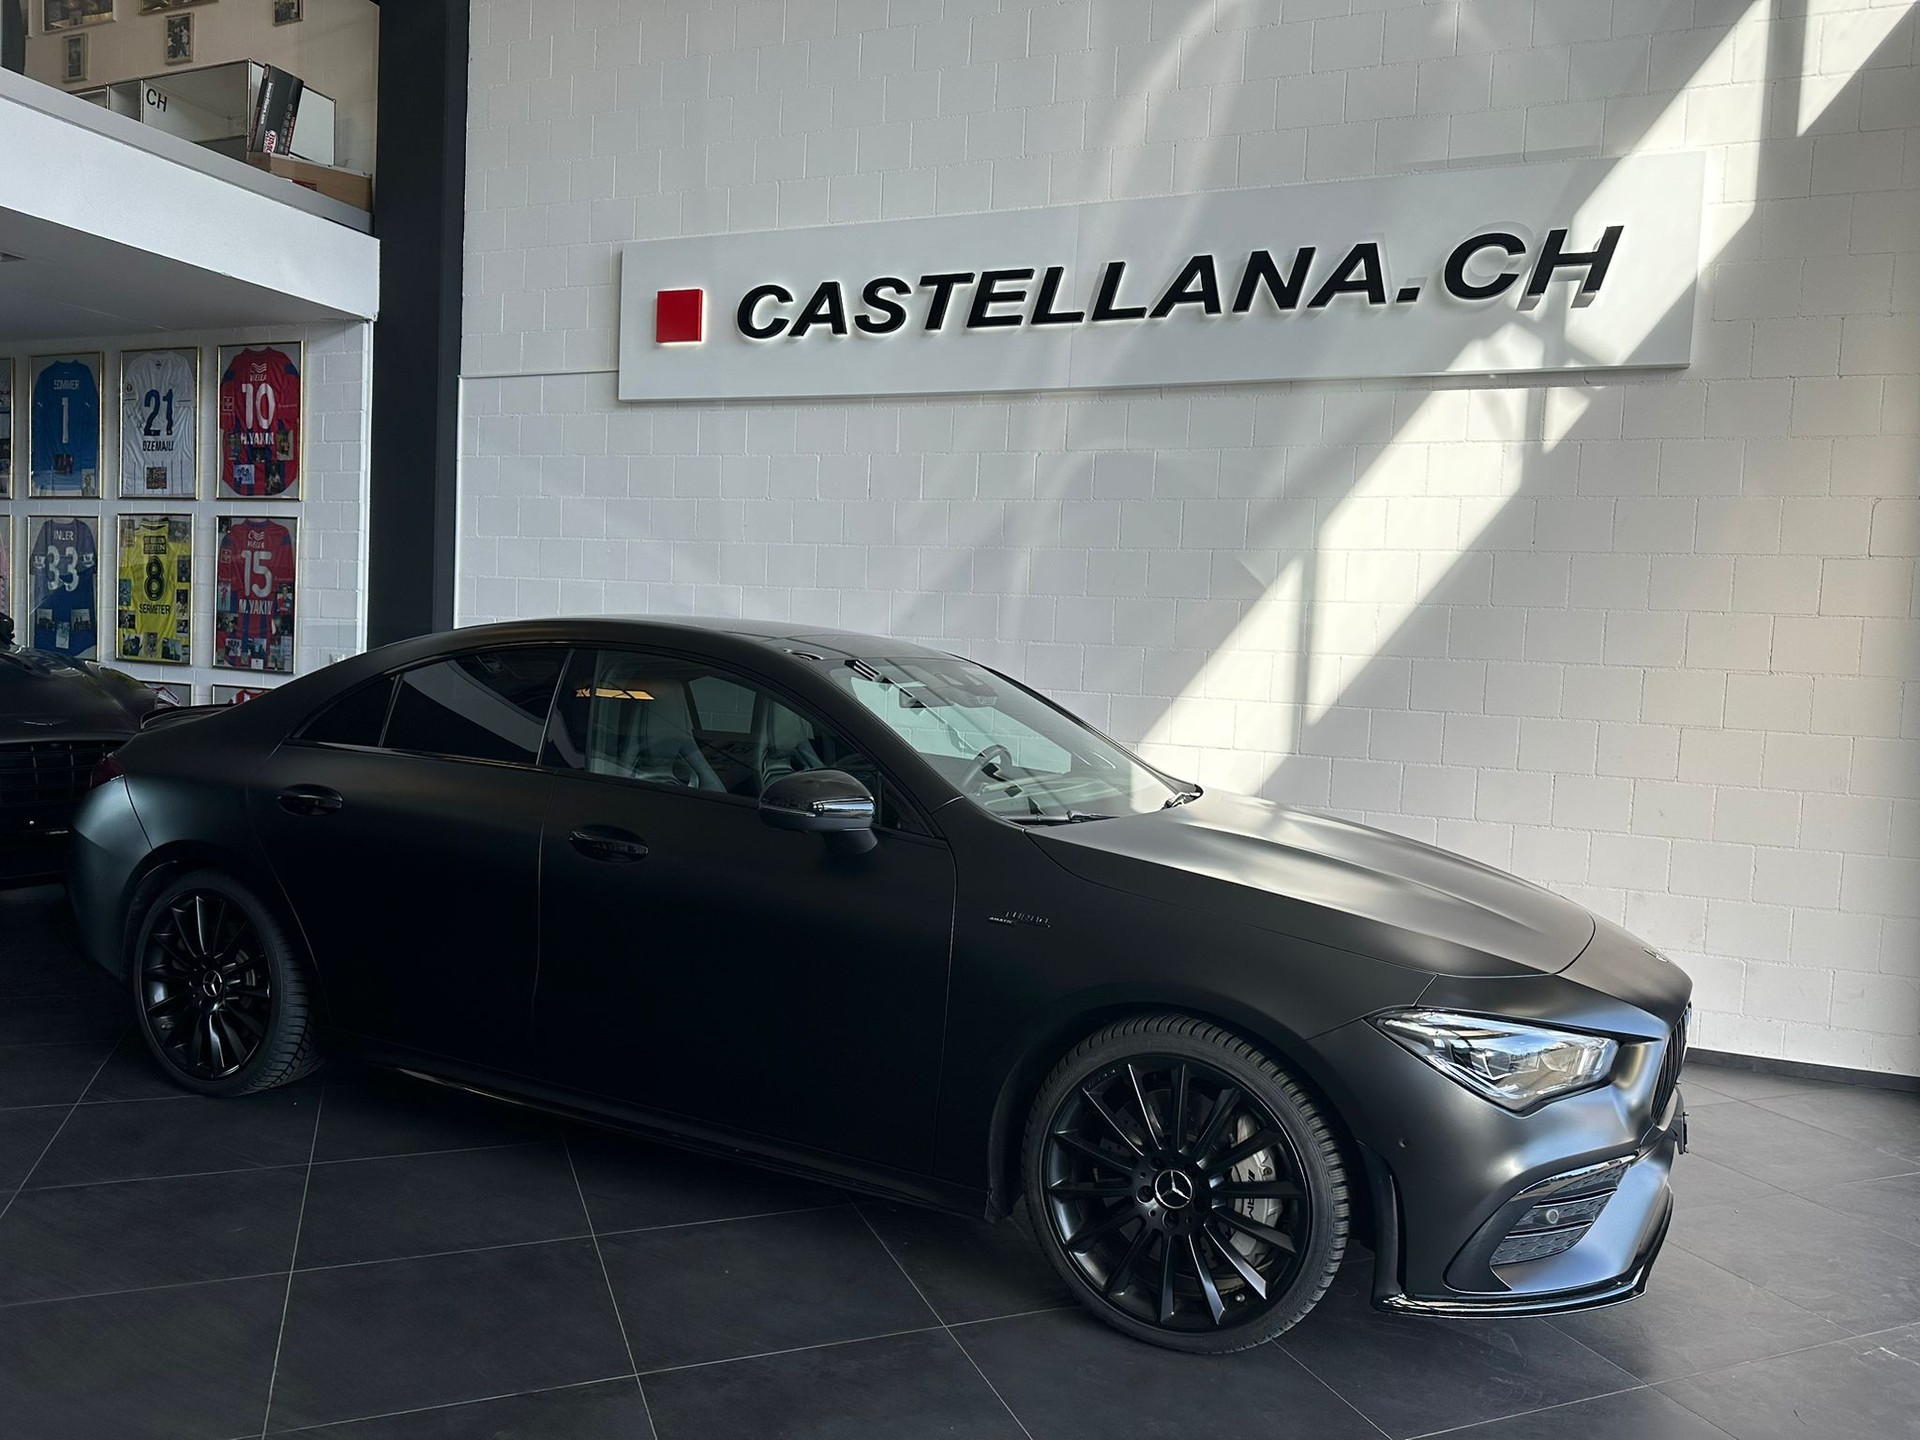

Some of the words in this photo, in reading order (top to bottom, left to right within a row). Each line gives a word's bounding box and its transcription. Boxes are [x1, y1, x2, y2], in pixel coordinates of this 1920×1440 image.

[146, 88, 168, 113] CH
[736, 225, 1624, 340] CASTELLANA.CH
[61, 396, 69, 444] 1
[143, 388, 174, 437] 21
[241, 383, 276, 430] 10
[47, 545, 79, 592] 33
[144, 555, 165, 602] 8
[241, 549, 273, 598] 15
